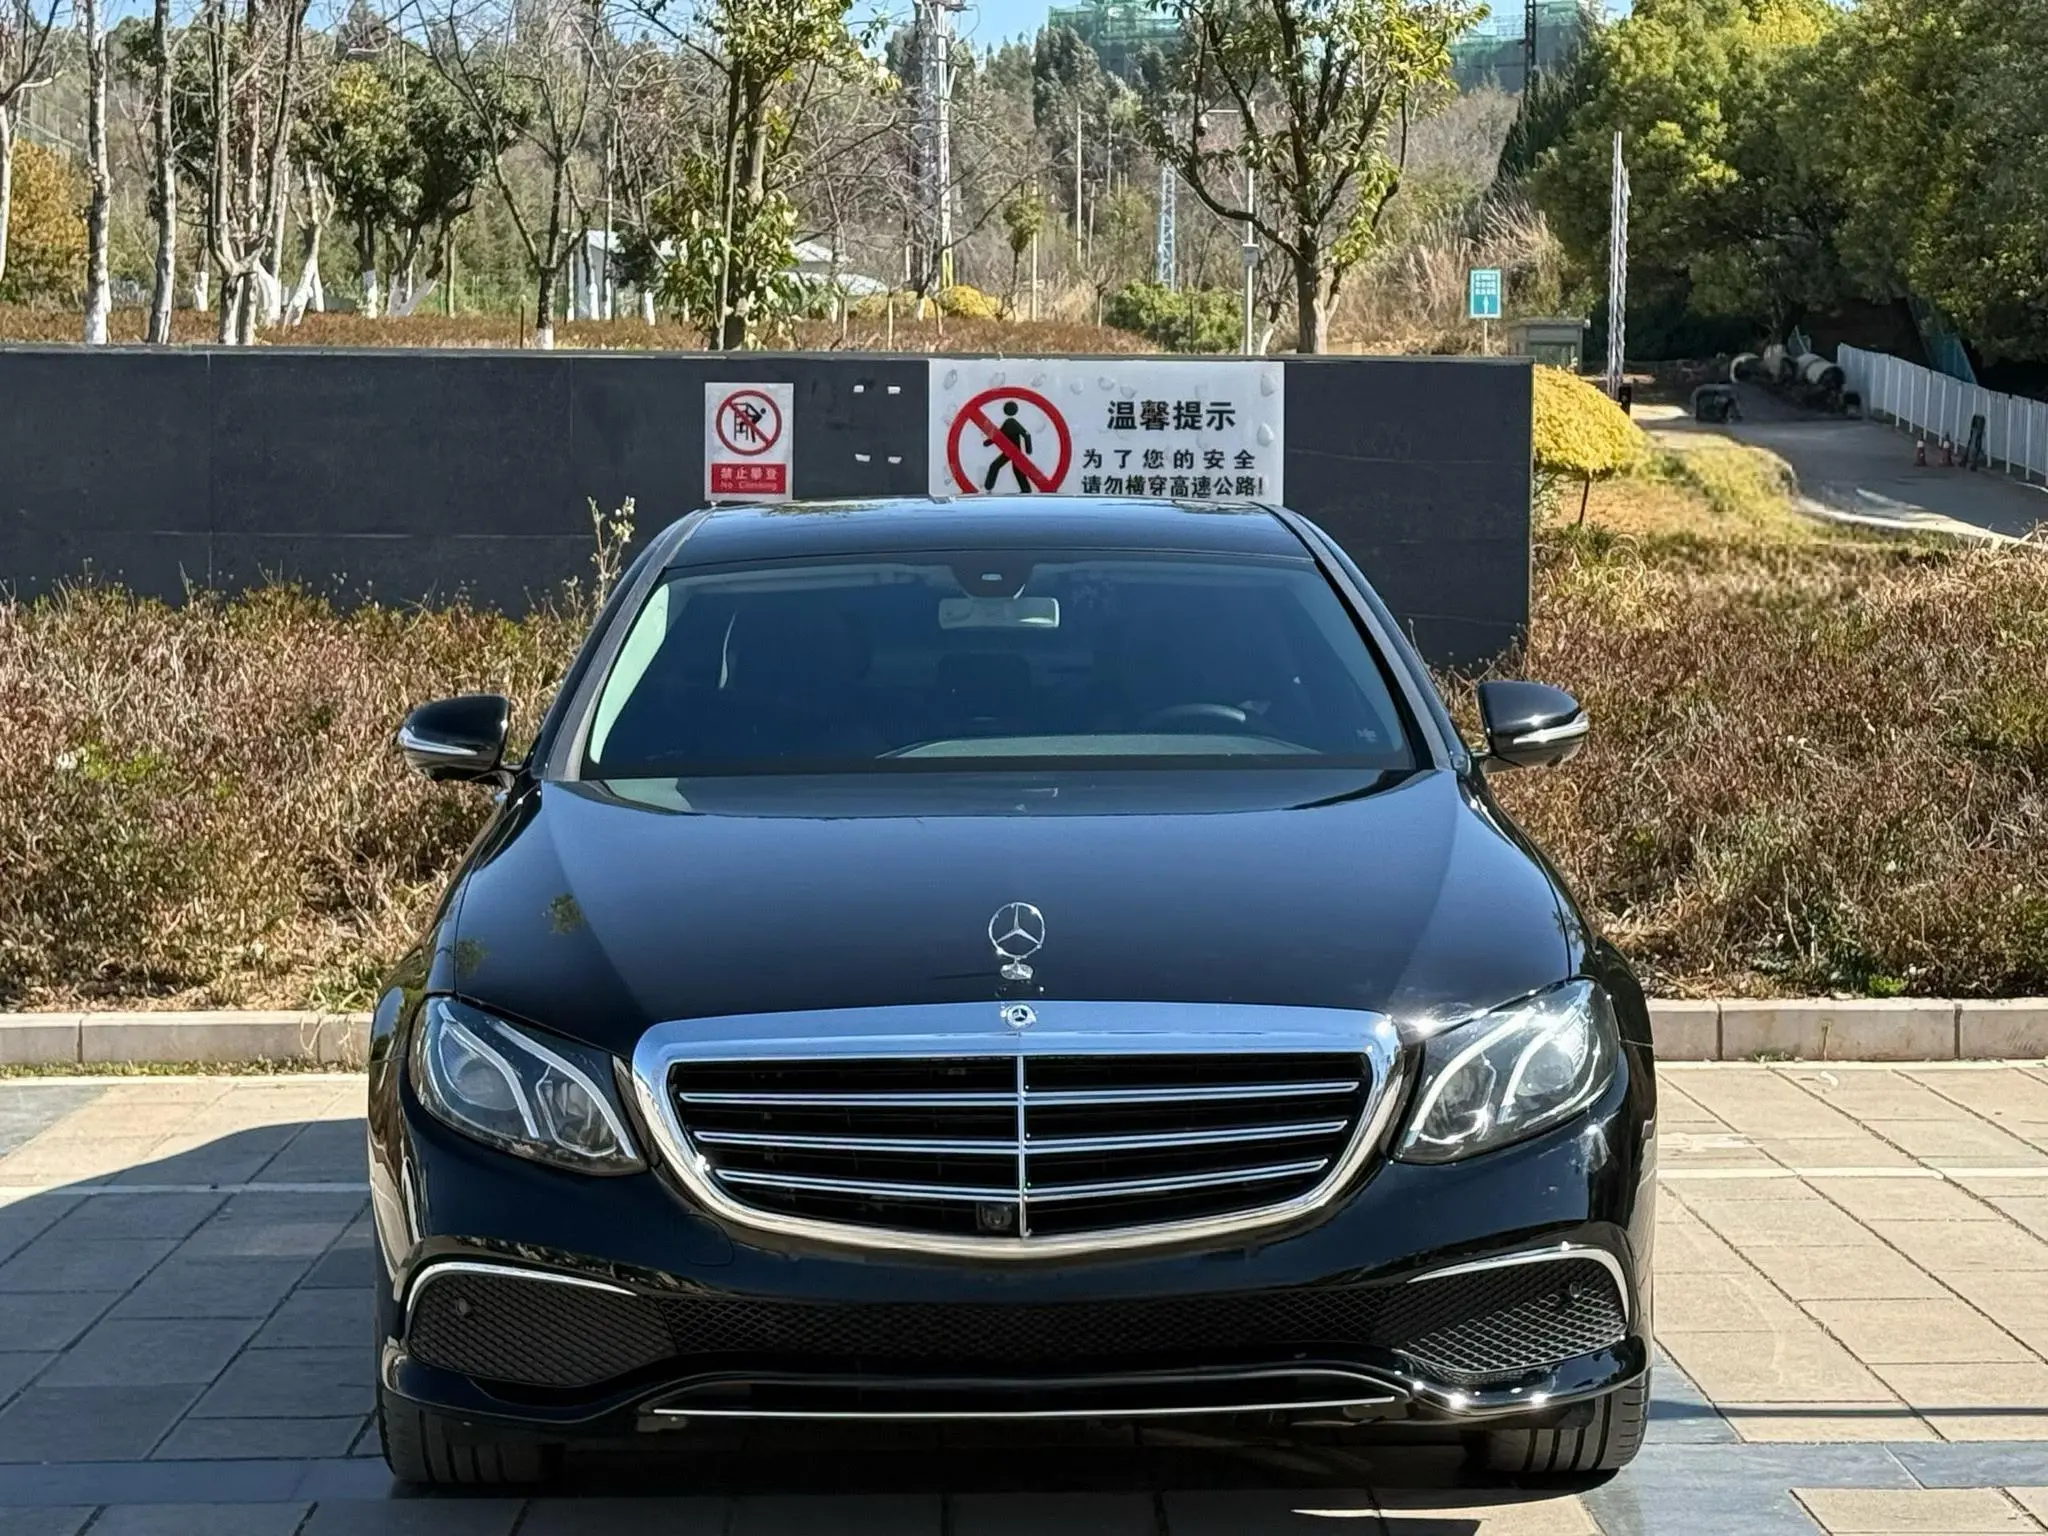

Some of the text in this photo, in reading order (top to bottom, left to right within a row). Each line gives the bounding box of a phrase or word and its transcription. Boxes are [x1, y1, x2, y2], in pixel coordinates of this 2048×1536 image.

[1107, 400, 1236, 431] 温馨提示
[1082, 448, 1256, 470] 为了您的安全
